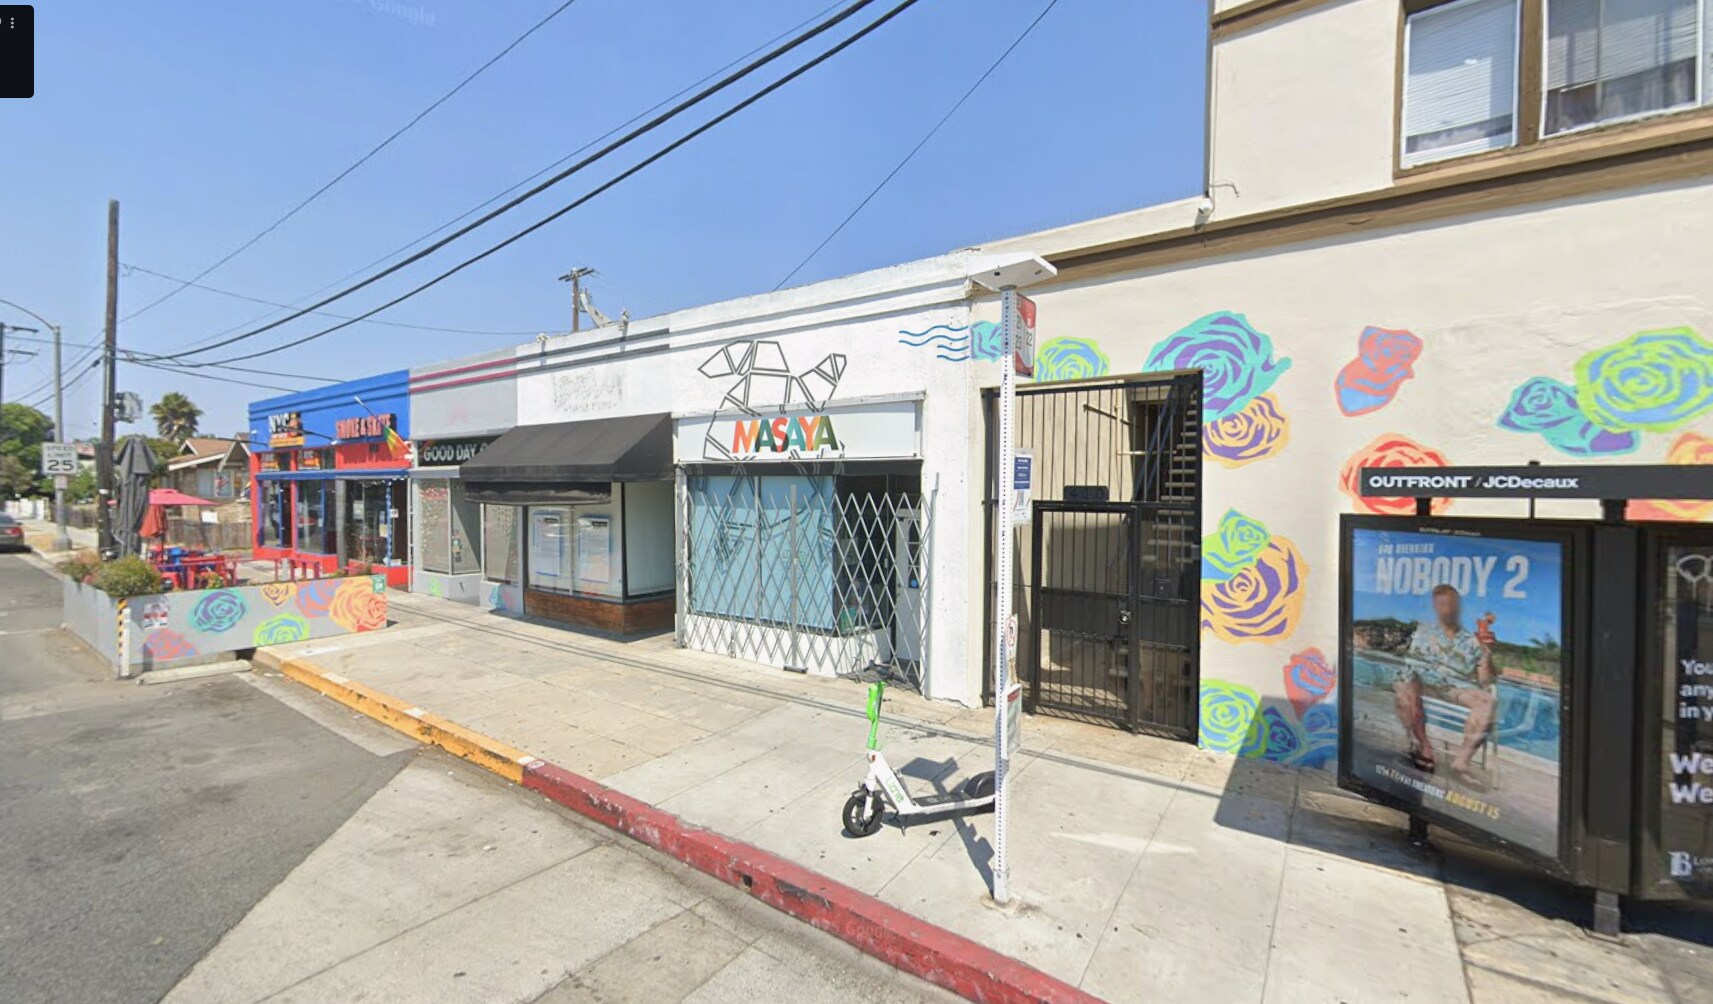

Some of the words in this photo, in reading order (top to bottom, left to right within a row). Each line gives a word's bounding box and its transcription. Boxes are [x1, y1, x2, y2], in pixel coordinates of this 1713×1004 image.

[336, 418, 360, 440] SMOKE
[732, 415, 839, 454] MASAYA
[423, 445, 455, 462] GOOD
[456, 443, 477, 460] DAY
[47, 459, 75, 472] 25
[1369, 475, 1473, 489] OUTFRONT
[1482, 476, 1579, 490] JCDecaux
[1376, 555, 1498, 598] NOBODY
[1502, 555, 1530, 599] 2
[1679, 702, 1700, 719] in
[1446, 789, 1487, 814] AUGUST
[1486, 804, 1500, 820] 15
